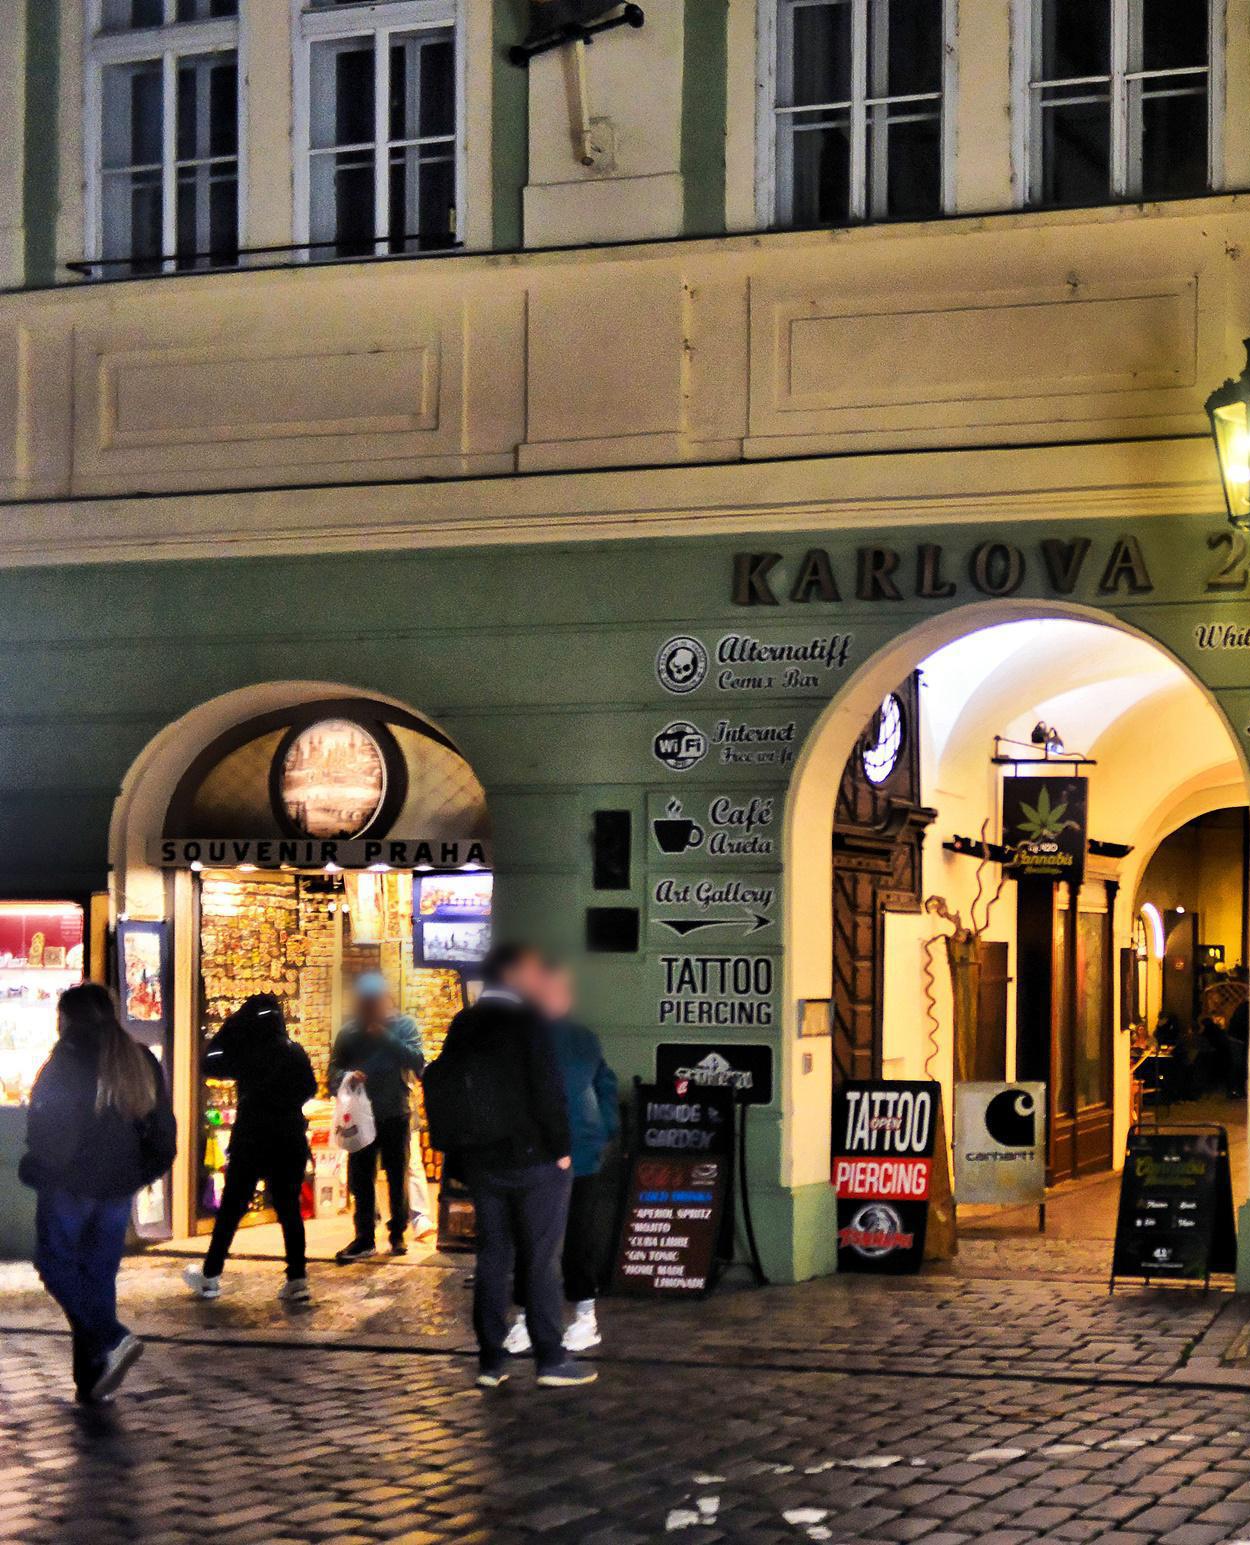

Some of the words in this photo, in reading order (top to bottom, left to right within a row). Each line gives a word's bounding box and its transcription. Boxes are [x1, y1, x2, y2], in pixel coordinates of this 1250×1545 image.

[732, 532, 1154, 607] KARLOVA
[718, 634, 851, 668] Alternatiff
[782, 668, 819, 689] Bar
[712, 720, 796, 743] Internet
[709, 797, 774, 833] Café
[162, 841, 339, 863] SOUVENIR
[364, 842, 486, 863] PRAHA
[655, 880, 691, 904] Art
[695, 880, 775, 911] Gallery
[660, 957, 773, 996] TATTOO
[659, 1000, 772, 1026] PIERCING
[845, 1091, 931, 1153] TATTOO
[965, 1150, 1035, 1163] carhartt
[835, 1161, 928, 1196] PIERCING
